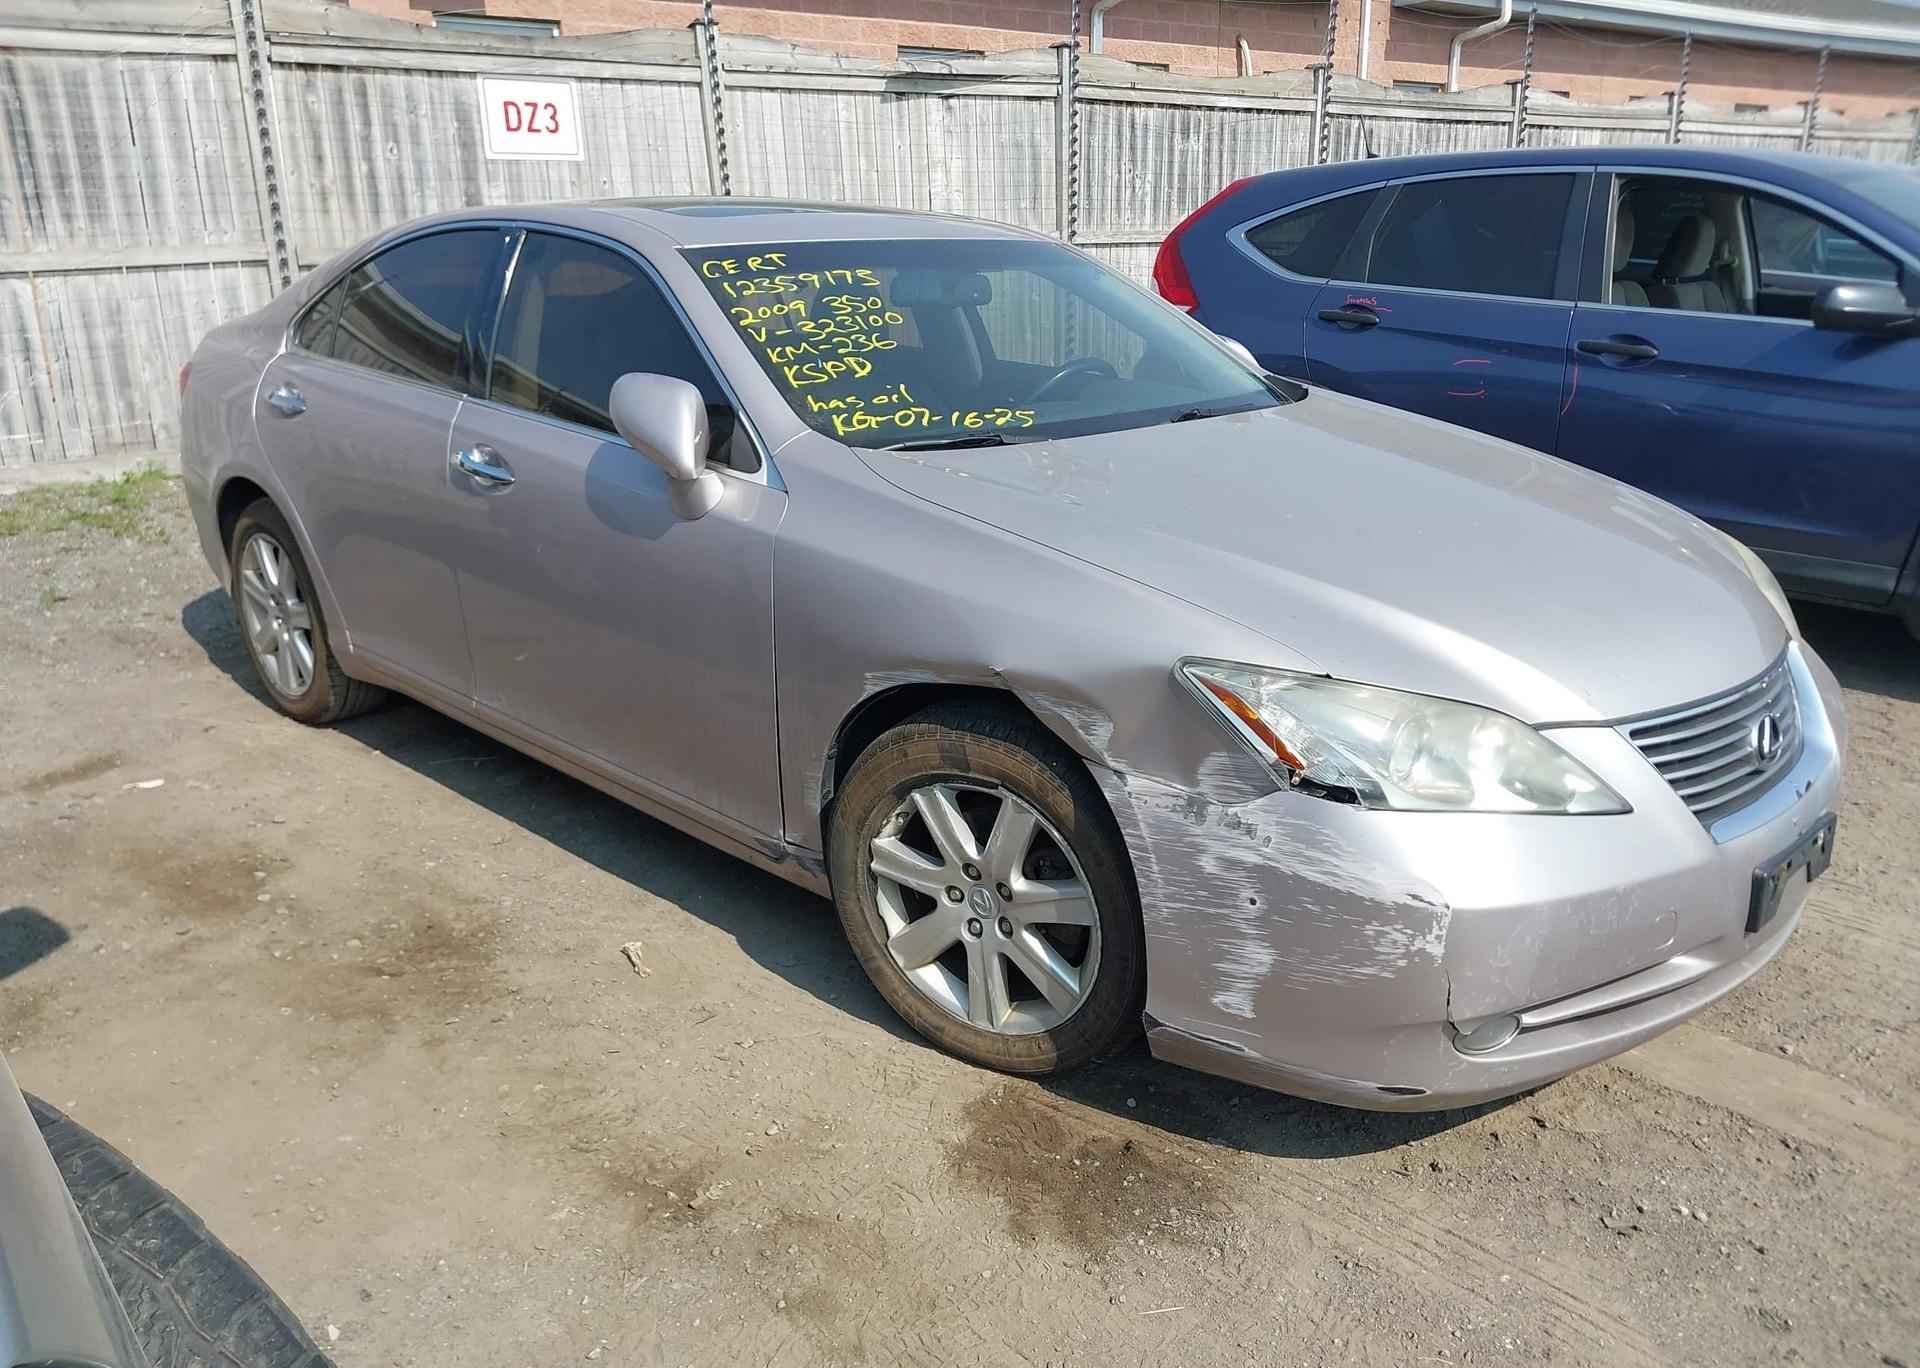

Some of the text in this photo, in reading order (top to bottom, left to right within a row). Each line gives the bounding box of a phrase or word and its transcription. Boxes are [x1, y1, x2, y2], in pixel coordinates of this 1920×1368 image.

[503, 101, 560, 134] DZ3
[702, 253, 787, 278] CERT
[730, 294, 882, 326] 2009 350
[806, 383, 914, 413] has oil
